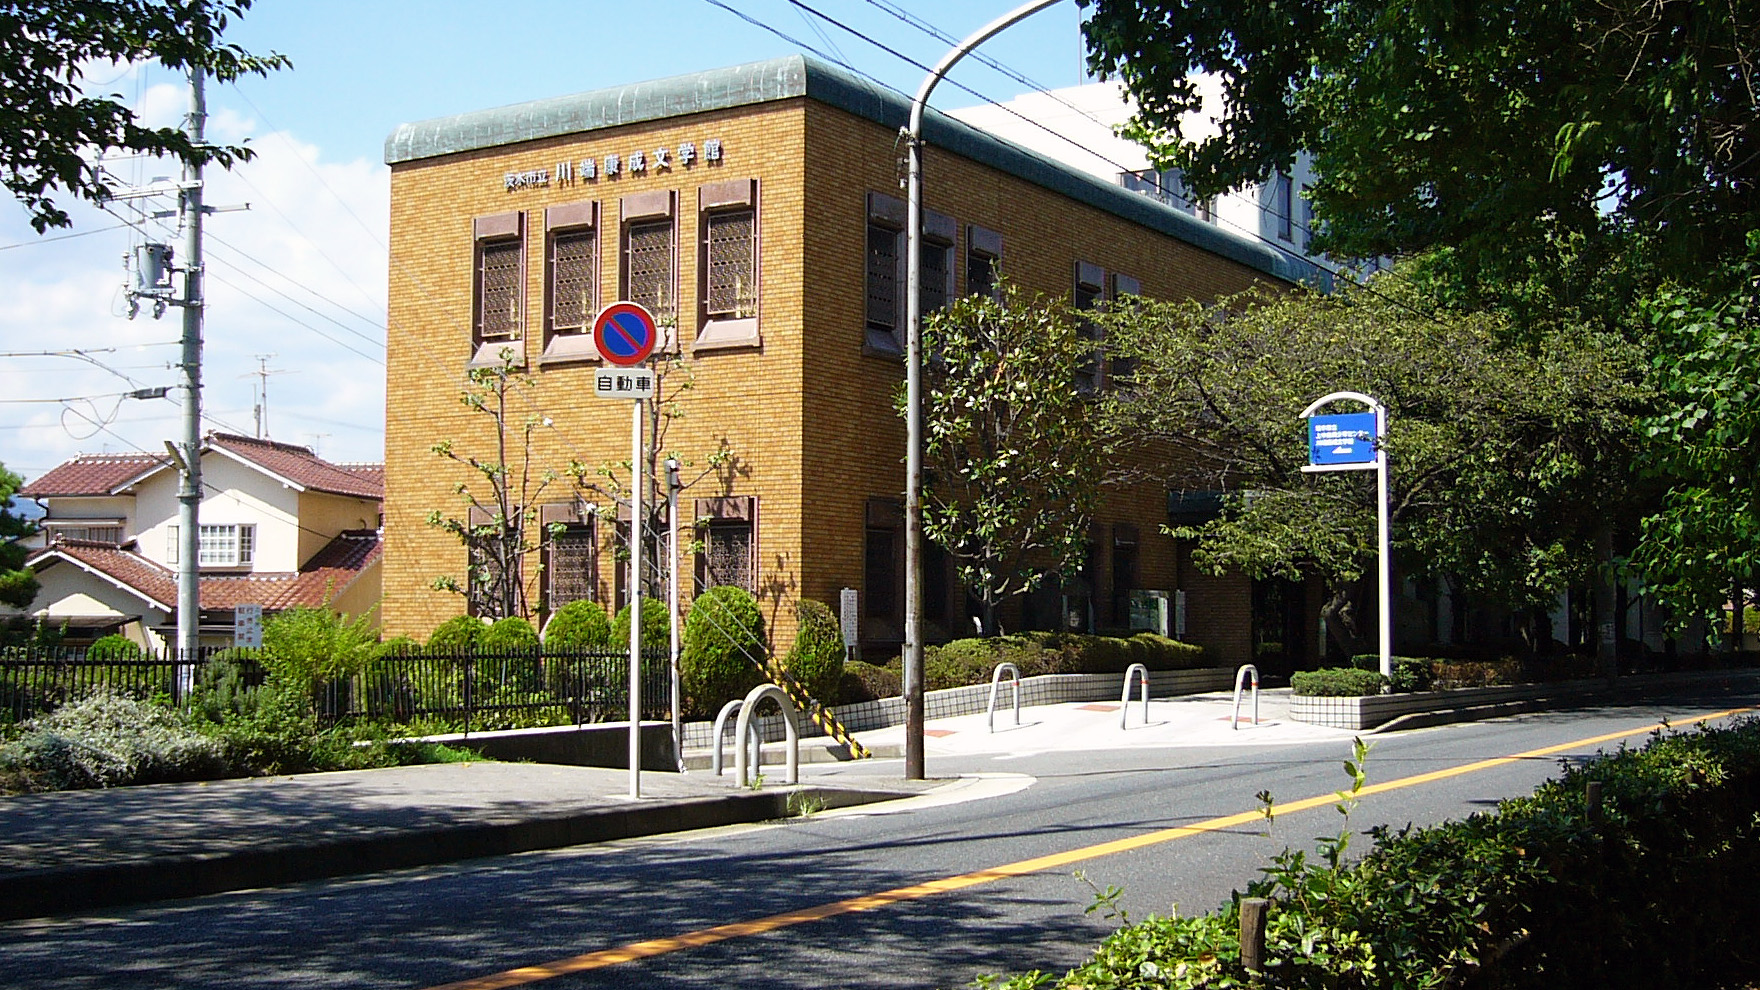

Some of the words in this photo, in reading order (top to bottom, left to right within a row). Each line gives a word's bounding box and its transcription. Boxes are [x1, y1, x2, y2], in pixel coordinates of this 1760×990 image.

[555, 139, 721, 182] 川端康成文学館
[598, 375, 651, 391] 自動車
